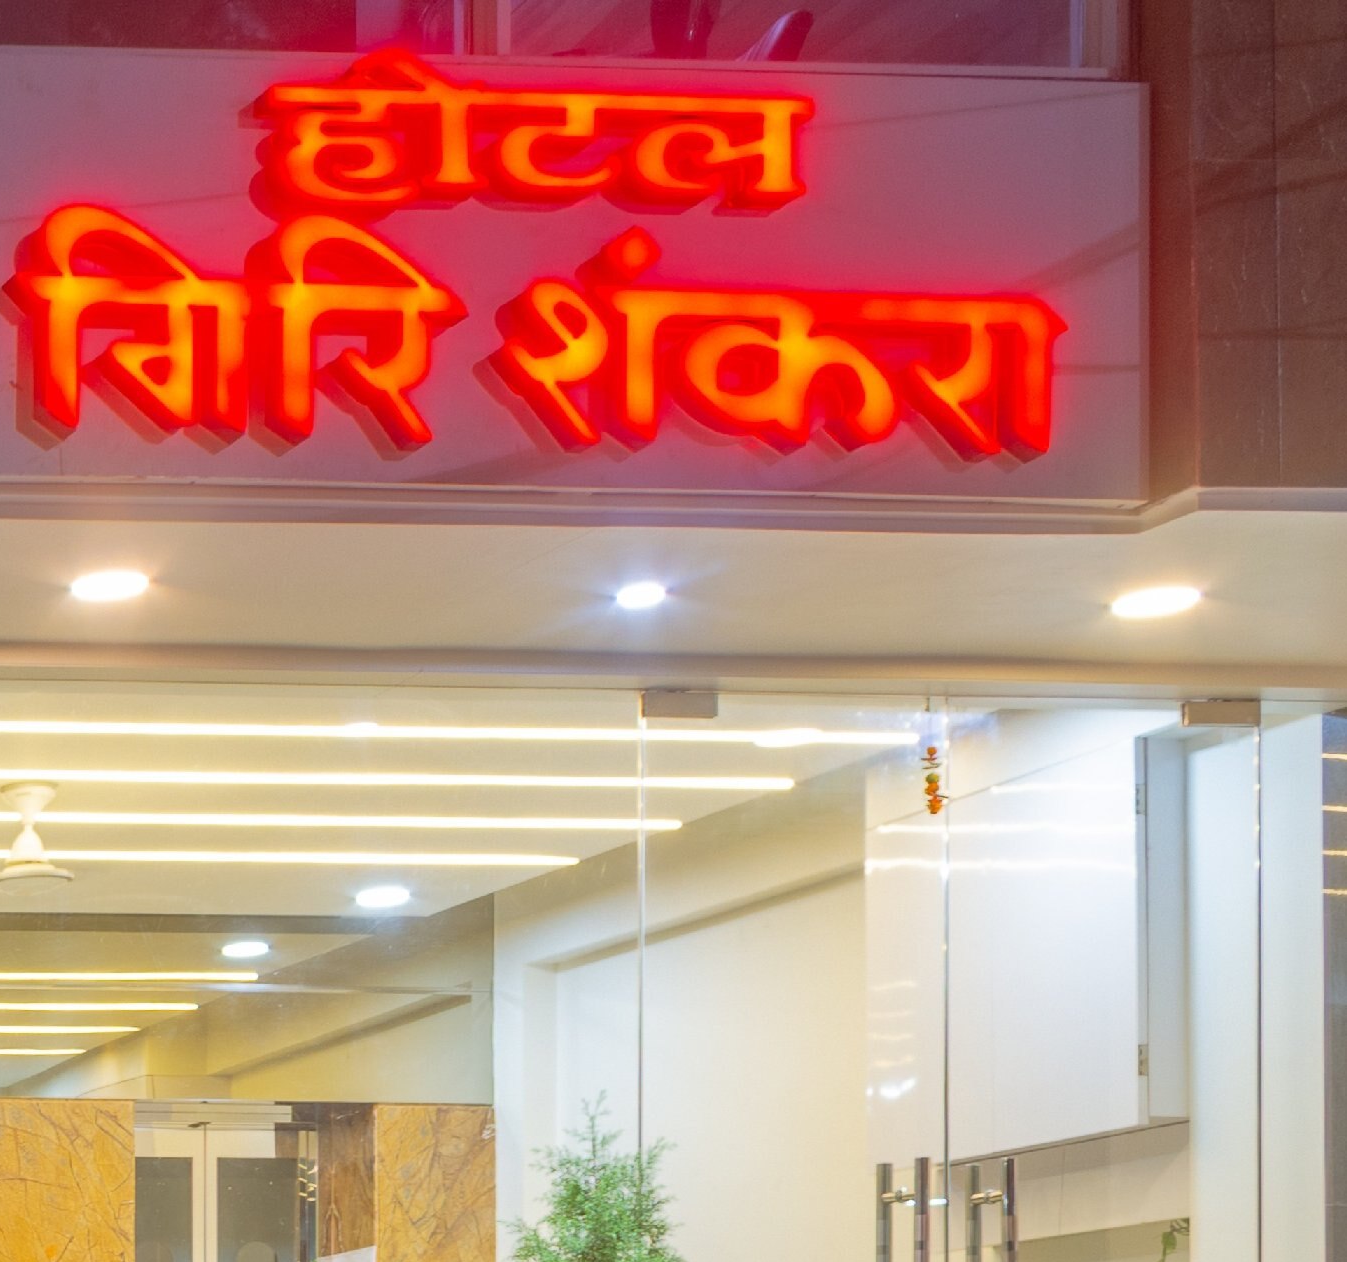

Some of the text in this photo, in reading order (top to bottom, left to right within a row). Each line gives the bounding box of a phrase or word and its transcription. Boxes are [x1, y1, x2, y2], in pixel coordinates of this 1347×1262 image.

[253, 50, 813, 208] होटल
[5, 203, 1067, 452] गिरि शंकरा
